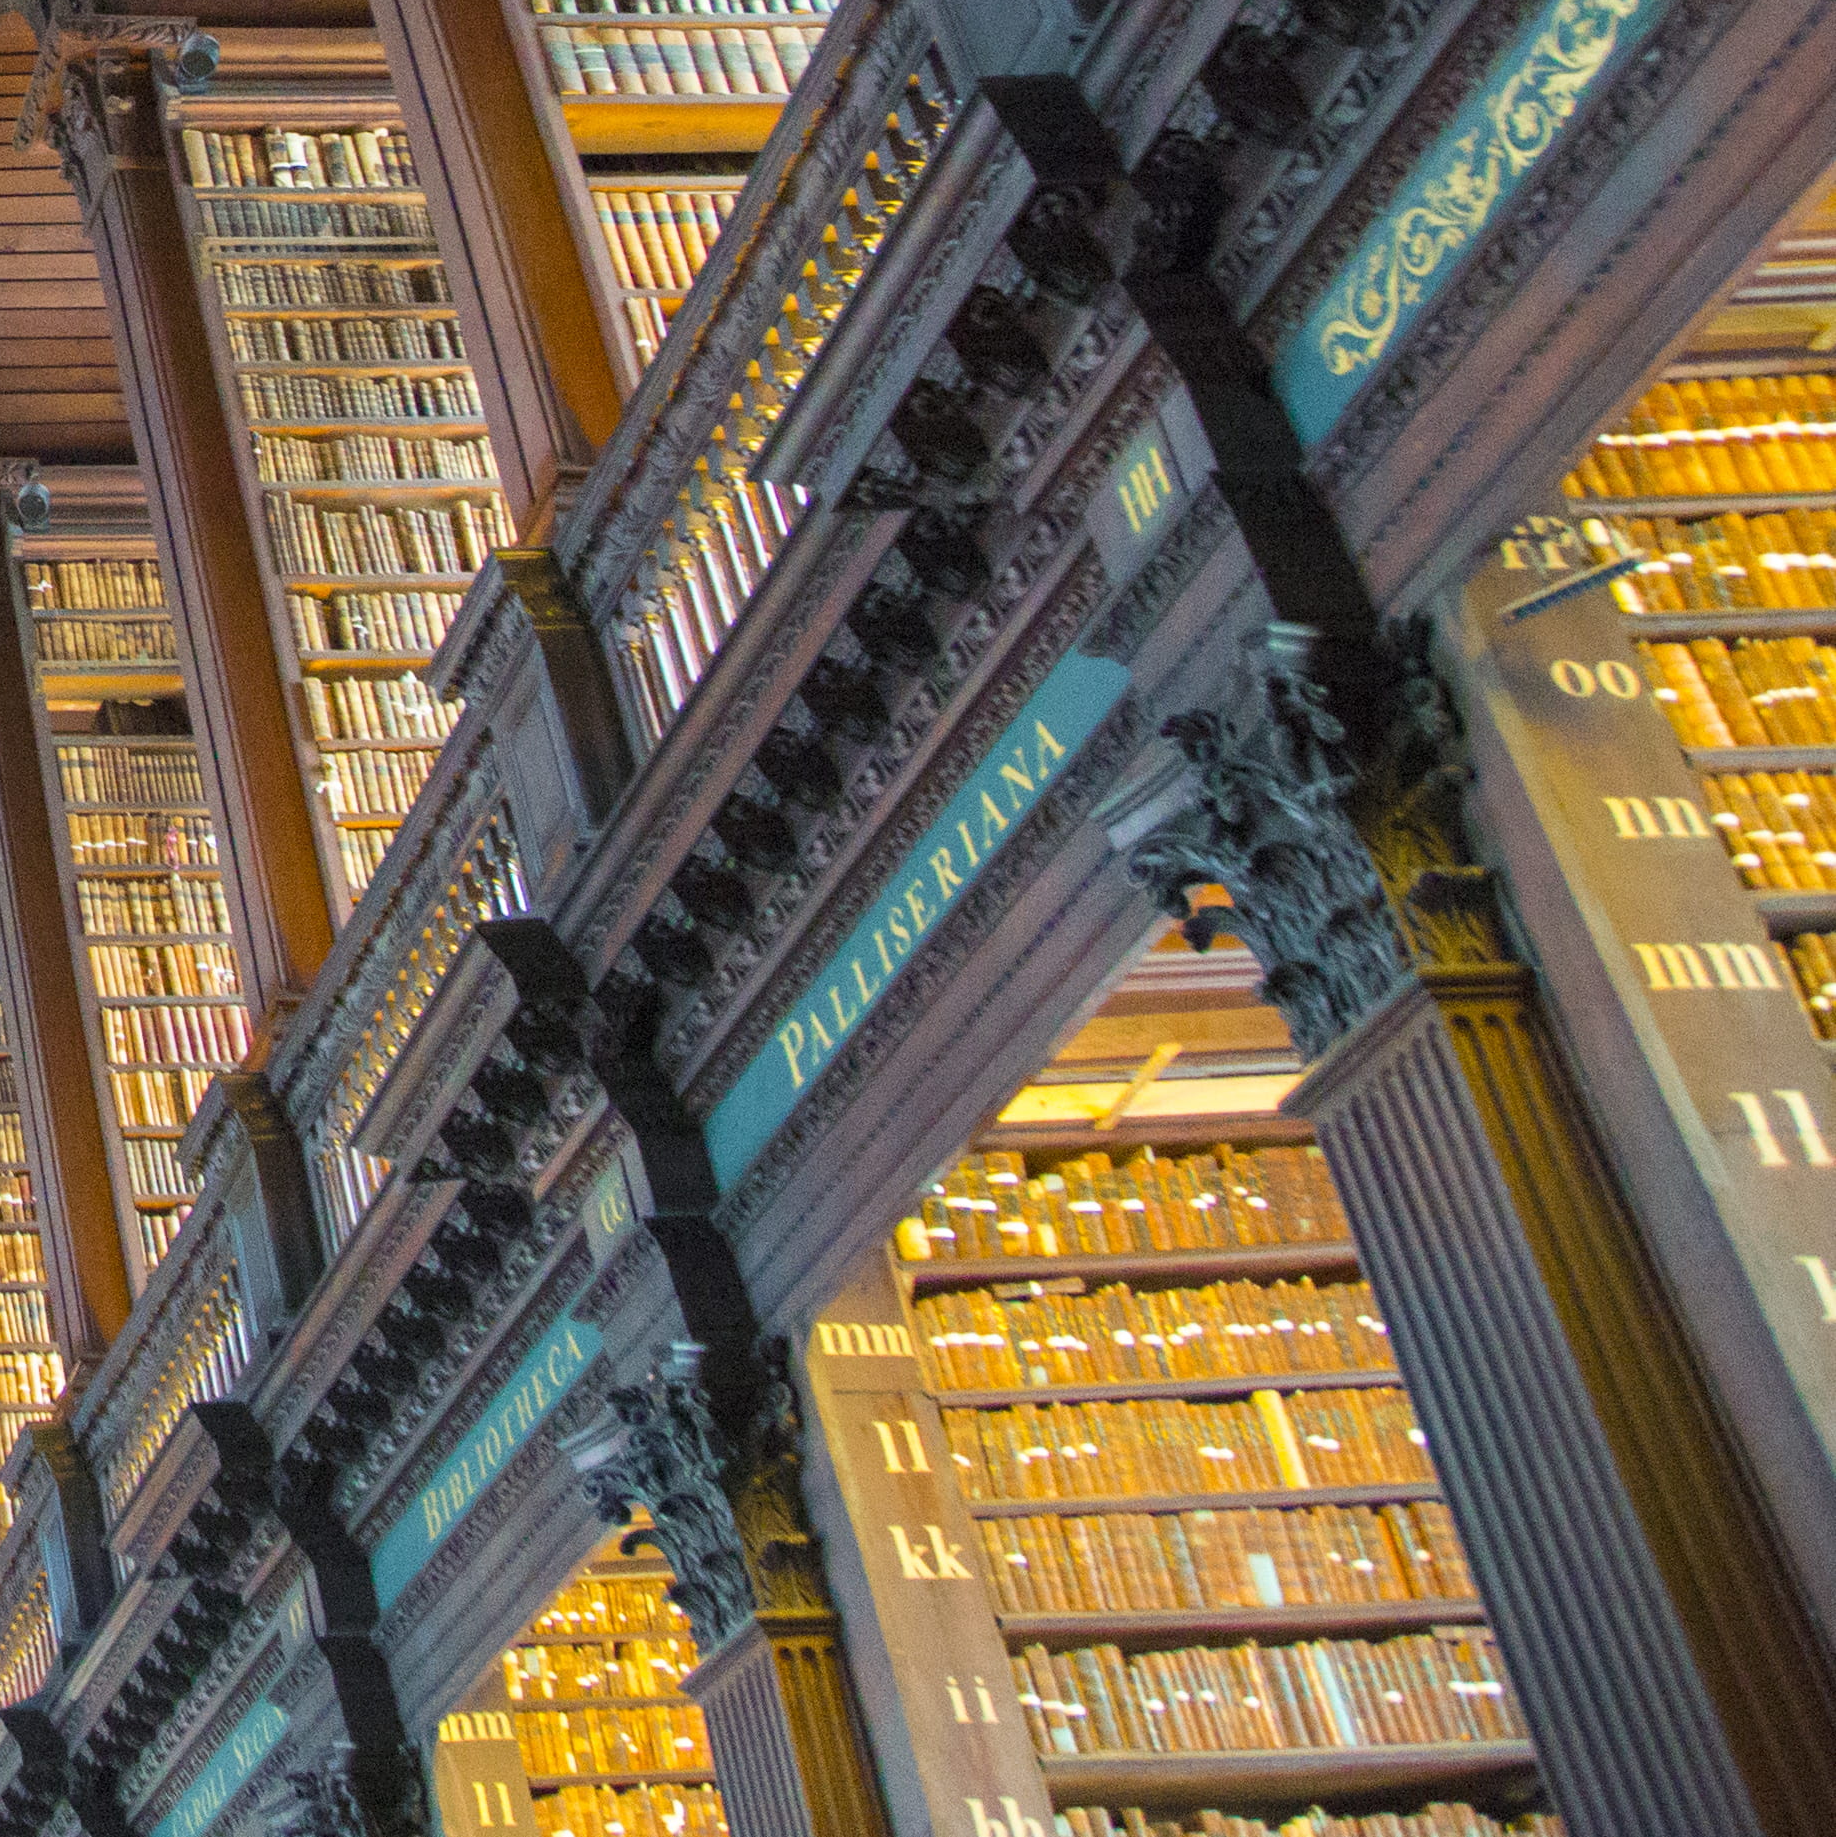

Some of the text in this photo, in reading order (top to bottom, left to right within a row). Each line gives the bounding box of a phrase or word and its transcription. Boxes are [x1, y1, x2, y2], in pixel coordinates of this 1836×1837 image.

[1551, 660, 1640, 699] oo
[1602, 797, 1711, 839] nn
[776, 718, 1067, 1091] PALLISERIANA
[1632, 943, 1782, 990] mm
[817, 1323, 914, 1356] mm
[422, 1328, 584, 1541] BIBLIOTHECA
[887, 1525, 973, 1579] kk
[946, 1676, 999, 1724] ii
